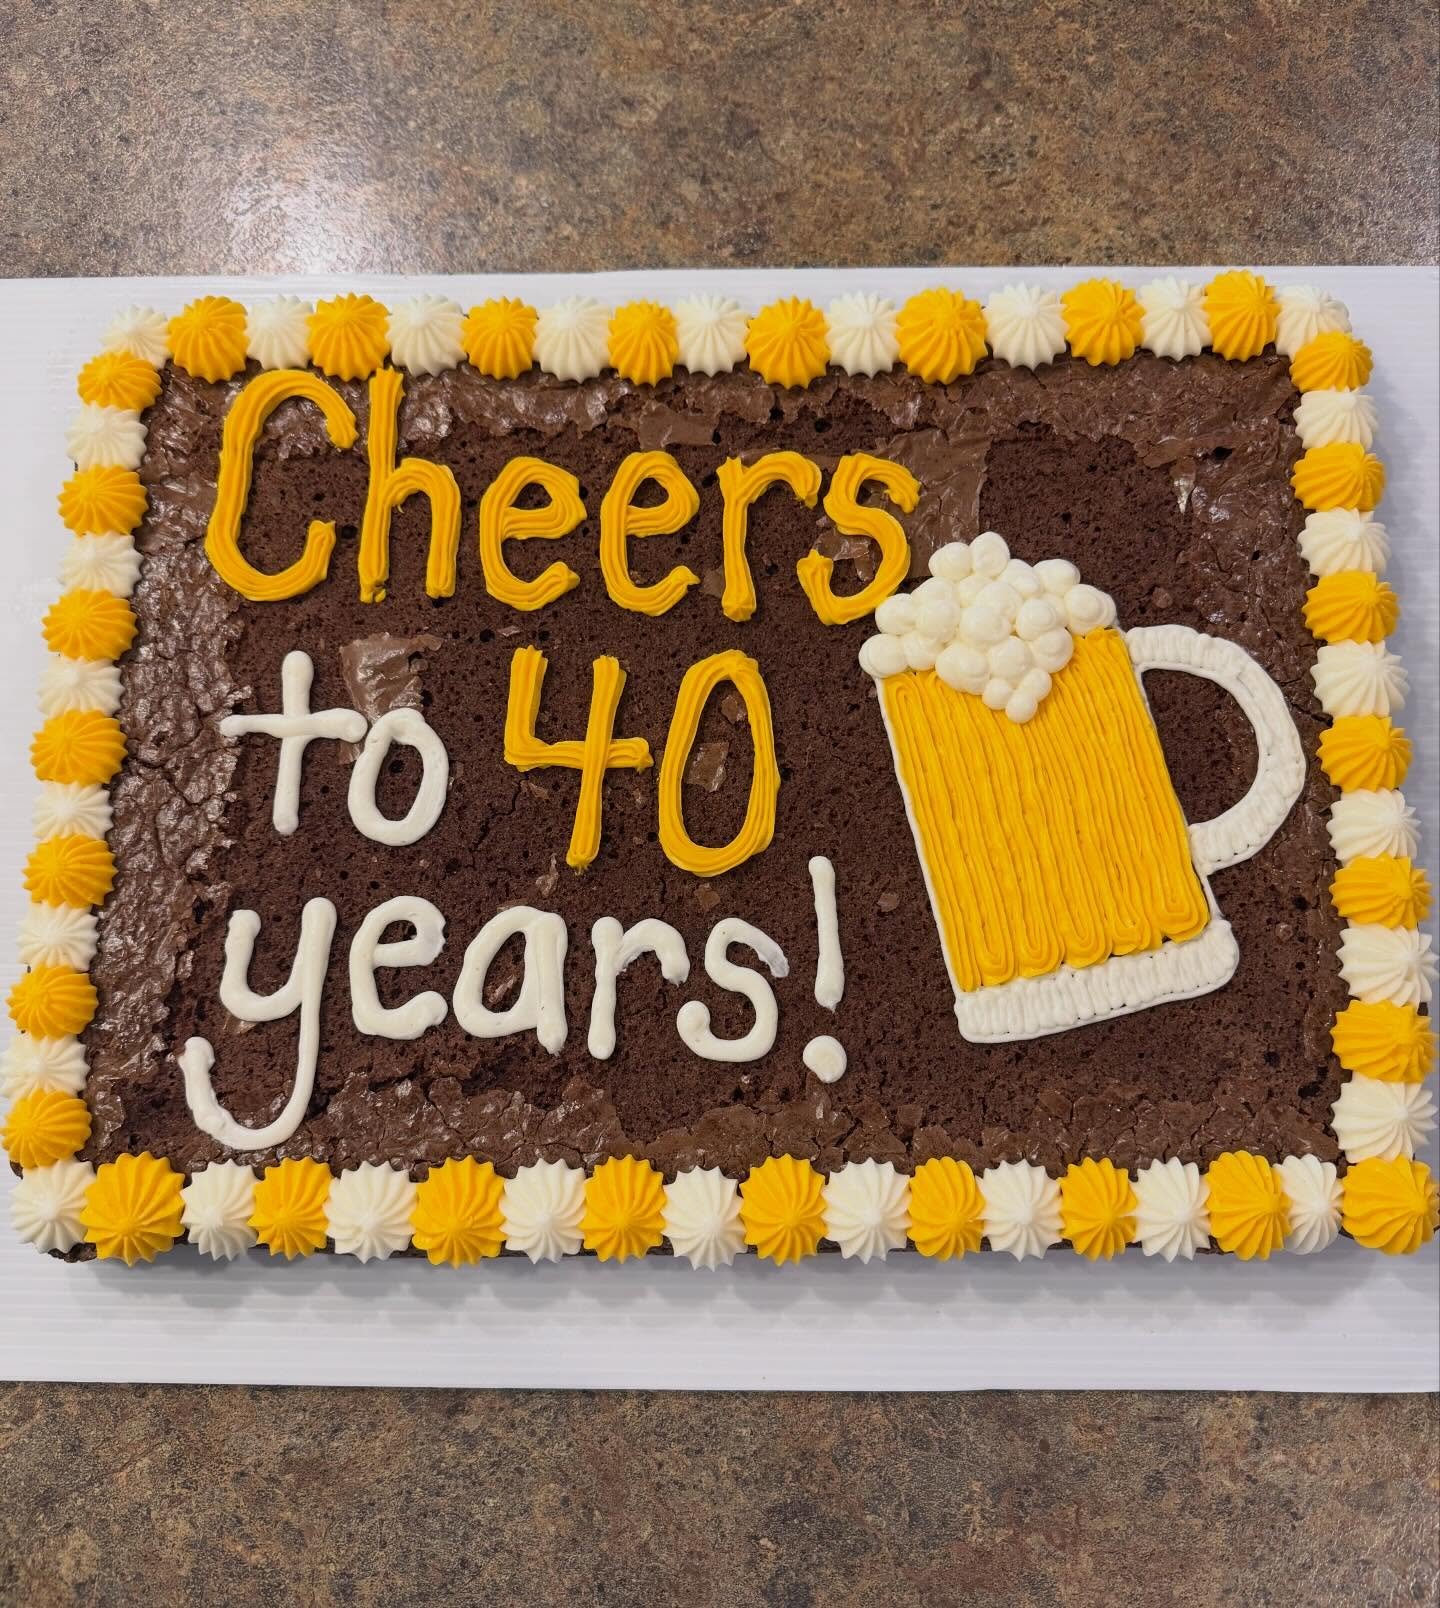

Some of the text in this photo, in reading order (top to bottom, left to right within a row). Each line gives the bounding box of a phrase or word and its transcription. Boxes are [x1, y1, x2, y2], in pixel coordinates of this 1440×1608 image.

[203, 366, 921, 625] Cheers
[219, 644, 782, 878] to 40
[178, 855, 848, 1151] years!
